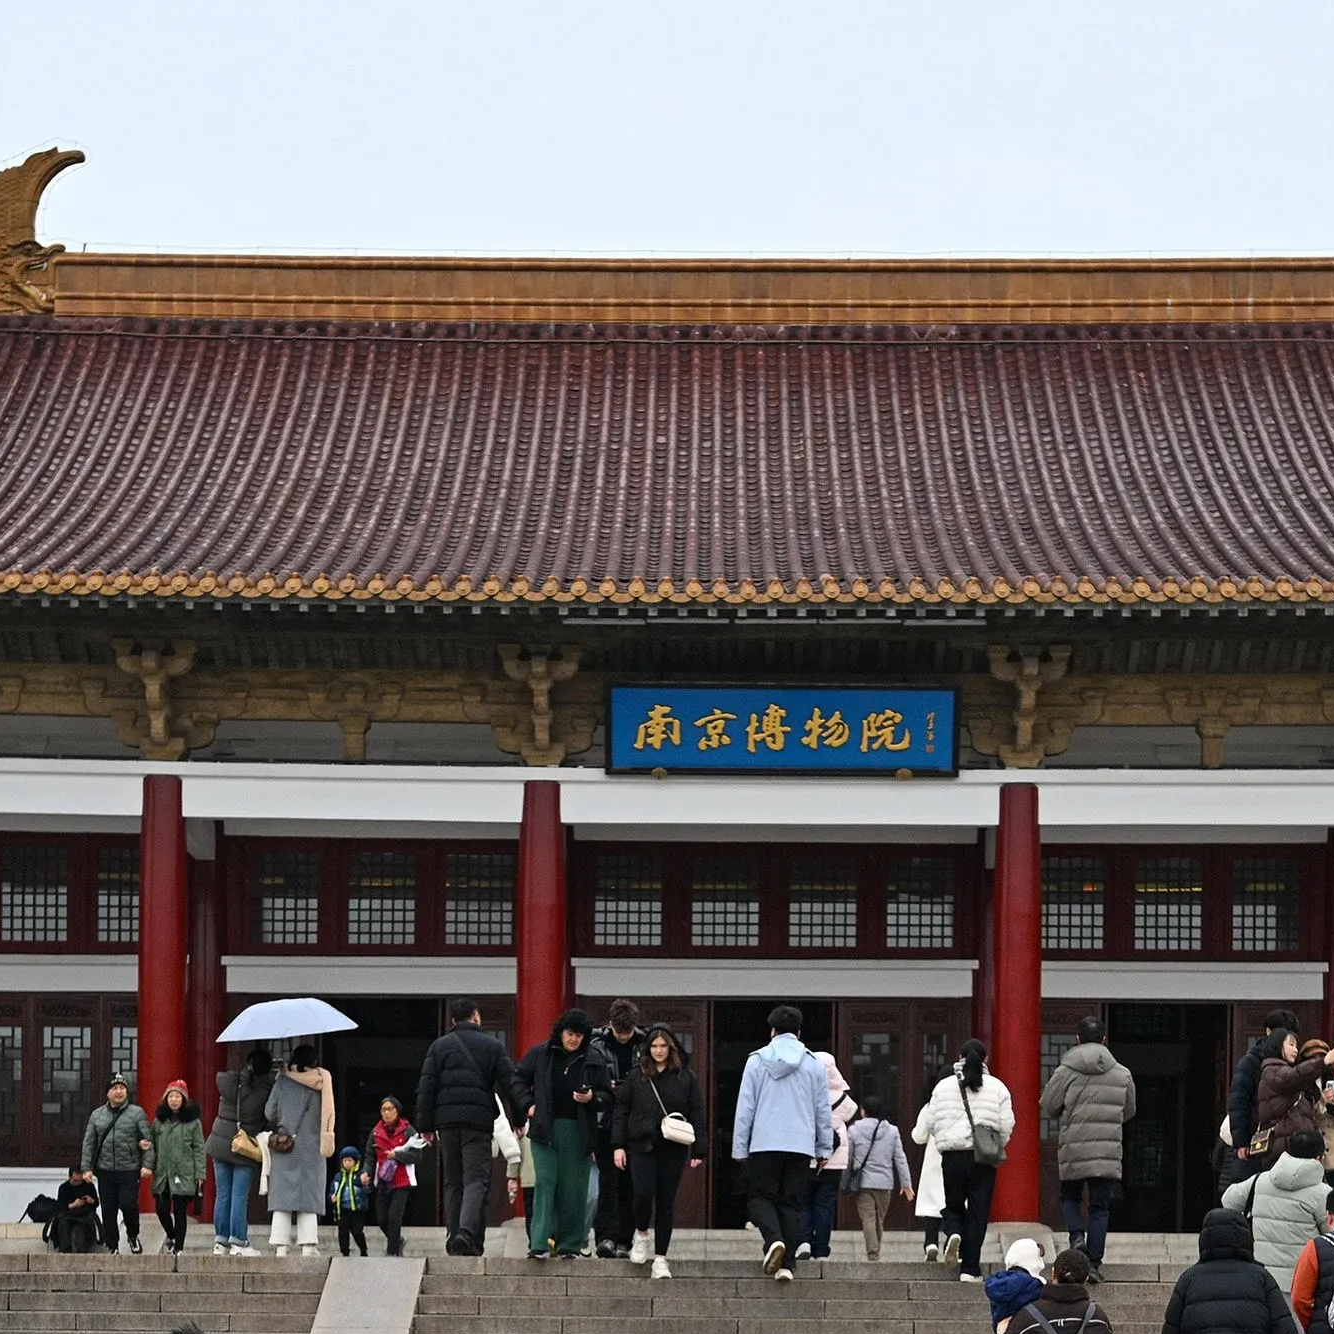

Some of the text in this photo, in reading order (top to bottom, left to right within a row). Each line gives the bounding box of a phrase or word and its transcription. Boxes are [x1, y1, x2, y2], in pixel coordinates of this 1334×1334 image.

[633, 703, 911, 753] 南京博物院
